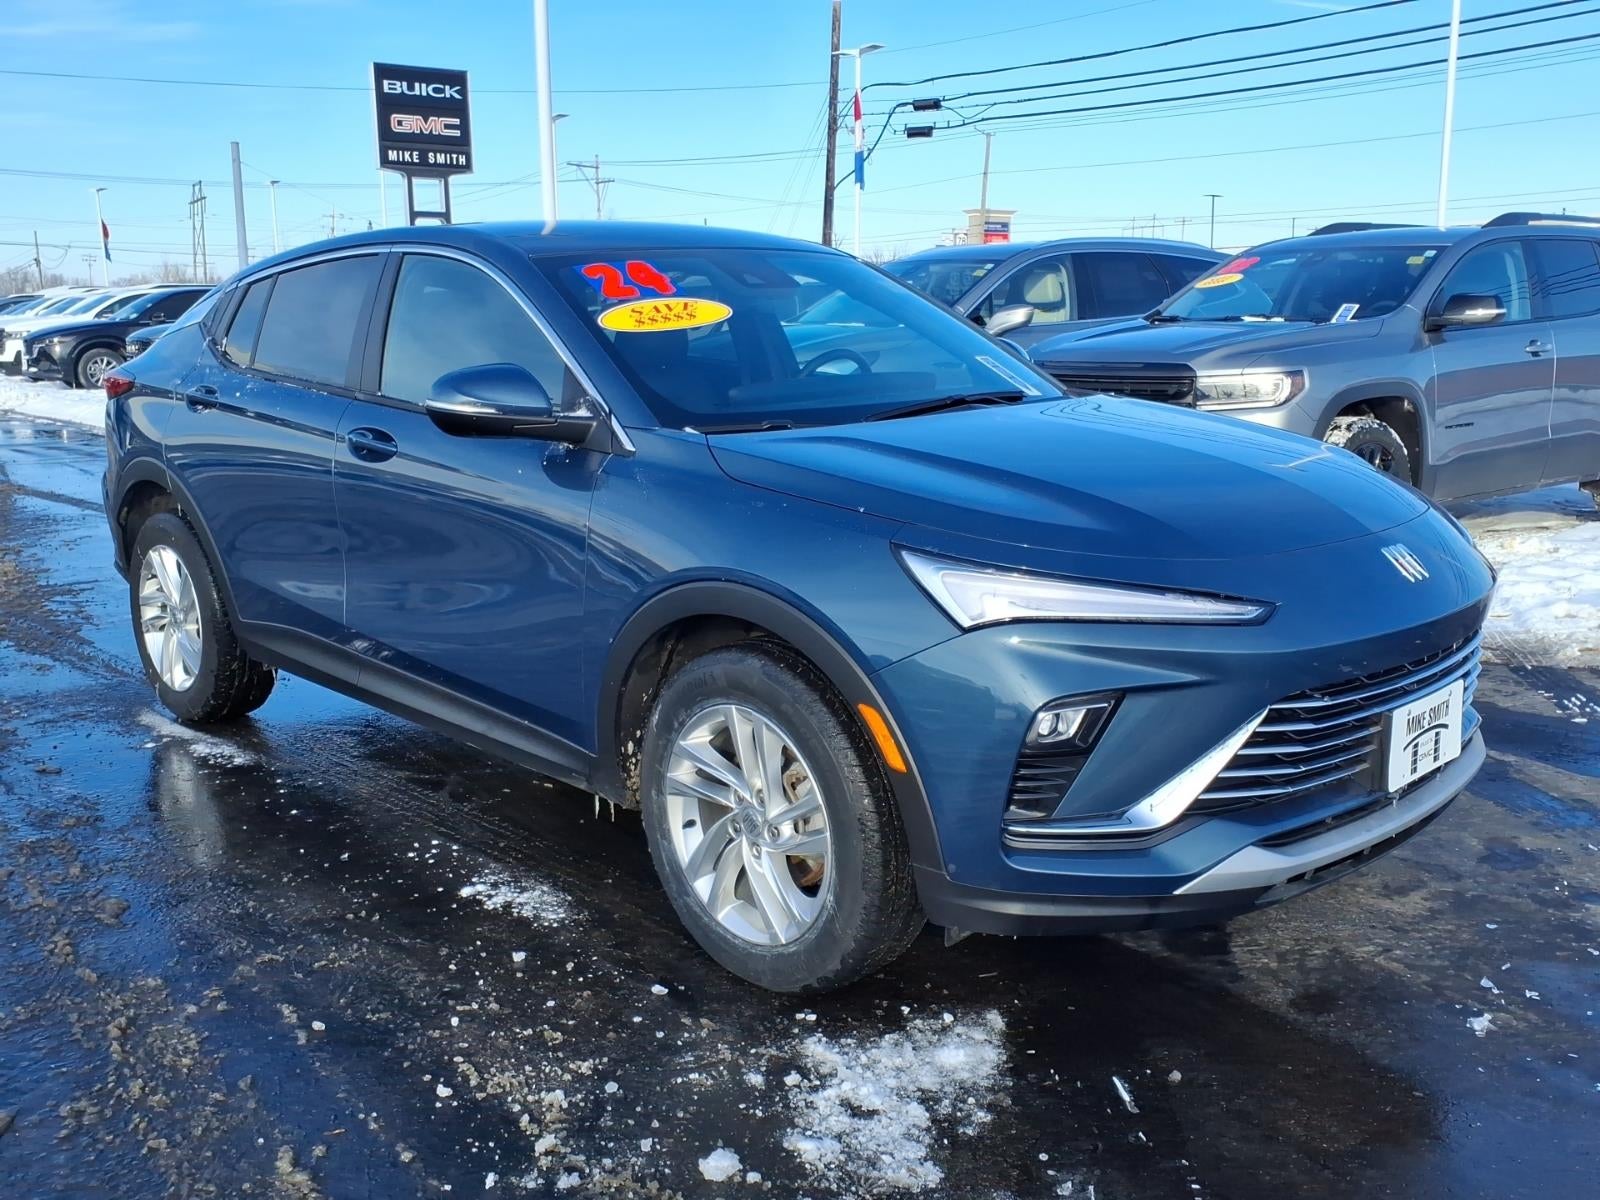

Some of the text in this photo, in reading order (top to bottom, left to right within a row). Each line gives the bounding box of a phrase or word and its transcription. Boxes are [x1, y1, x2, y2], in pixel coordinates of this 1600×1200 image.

[383, 79, 462, 99] BUICK
[390, 113, 460, 136] GMC
[388, 149, 466, 165] MIKE SMITH
[581, 260, 677, 299] 24
[629, 300, 698, 318] SAVE
[1407, 700, 1450, 736] MIKE SMITH
